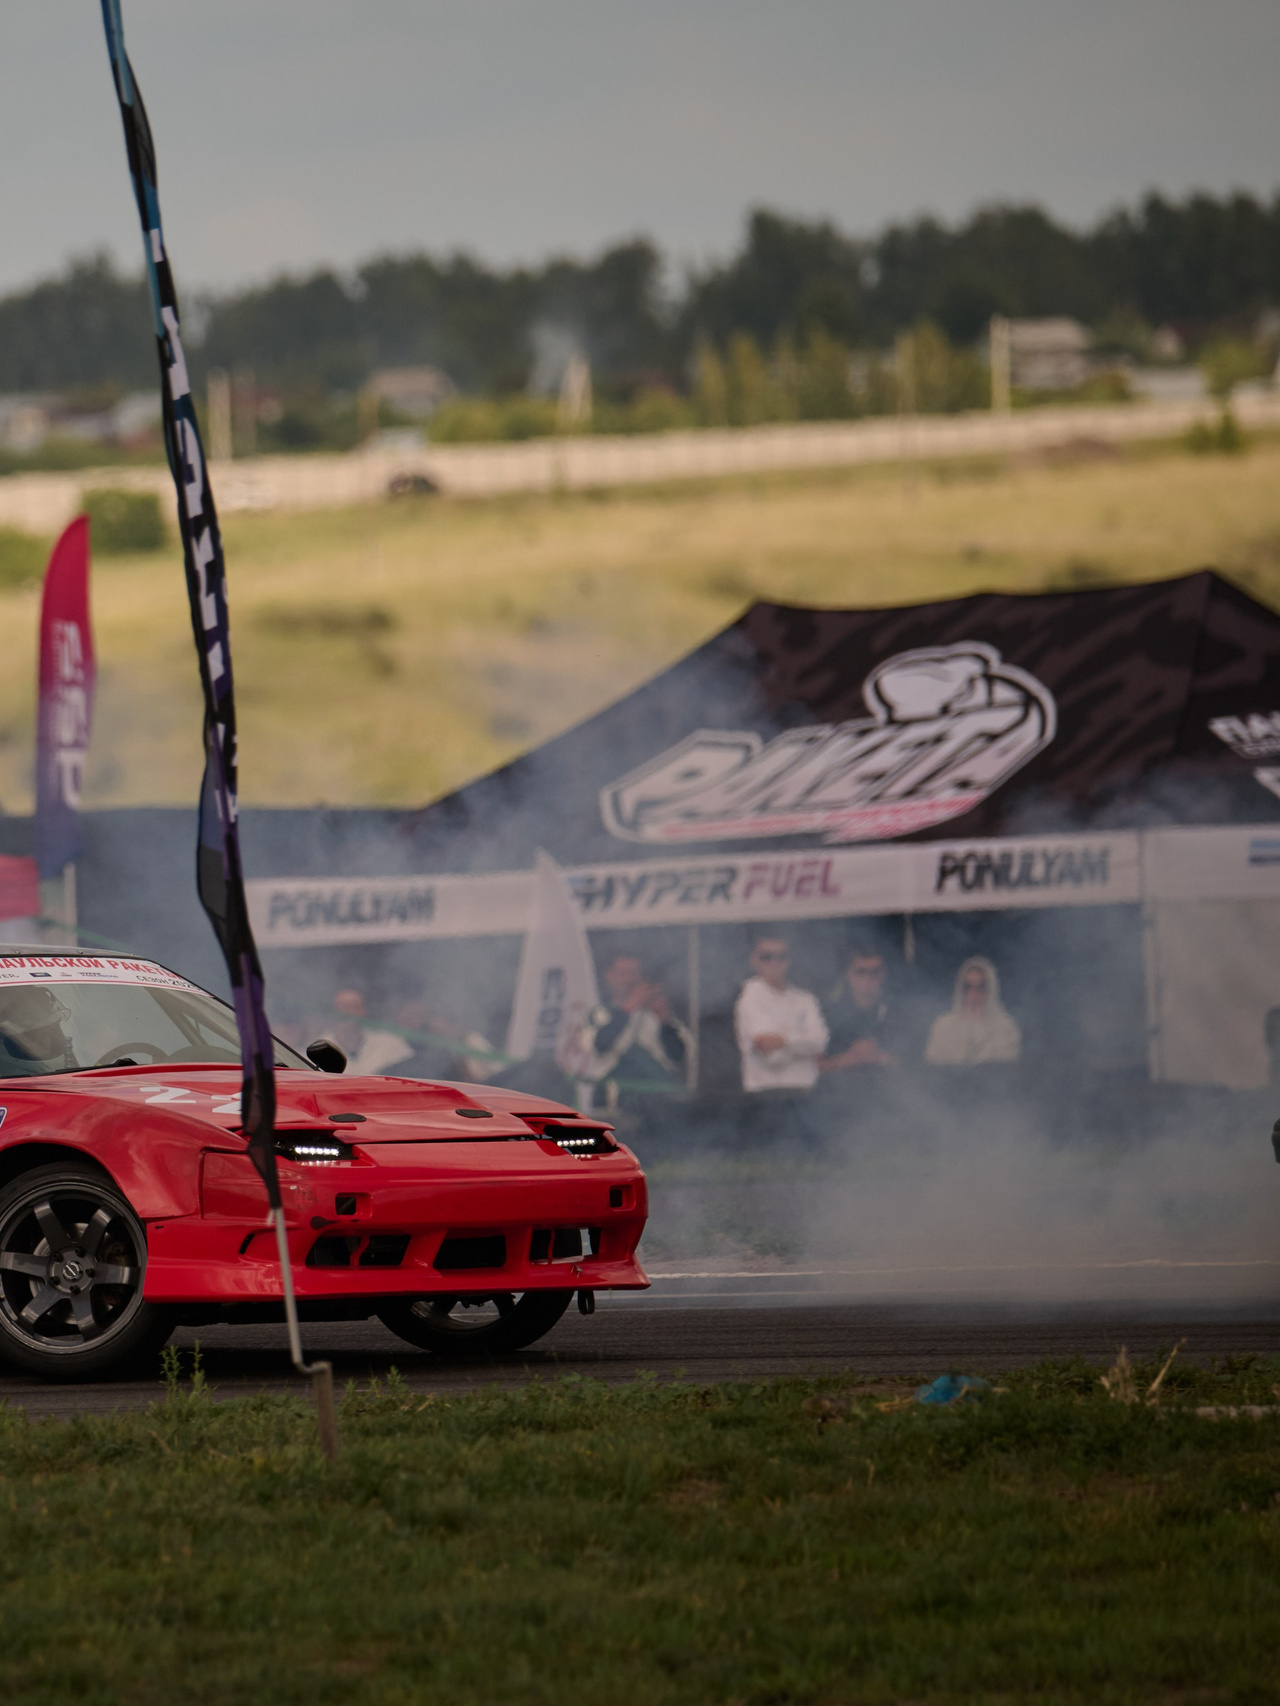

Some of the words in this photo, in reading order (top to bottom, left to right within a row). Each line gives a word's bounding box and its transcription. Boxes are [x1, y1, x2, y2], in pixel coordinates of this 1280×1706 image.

[580, 866, 739, 911] HYPER
[741, 859, 841, 900] FUEL
[935, 844, 1111, 893] PONULYAM
[136, 975, 169, 985] СЕЗОН
